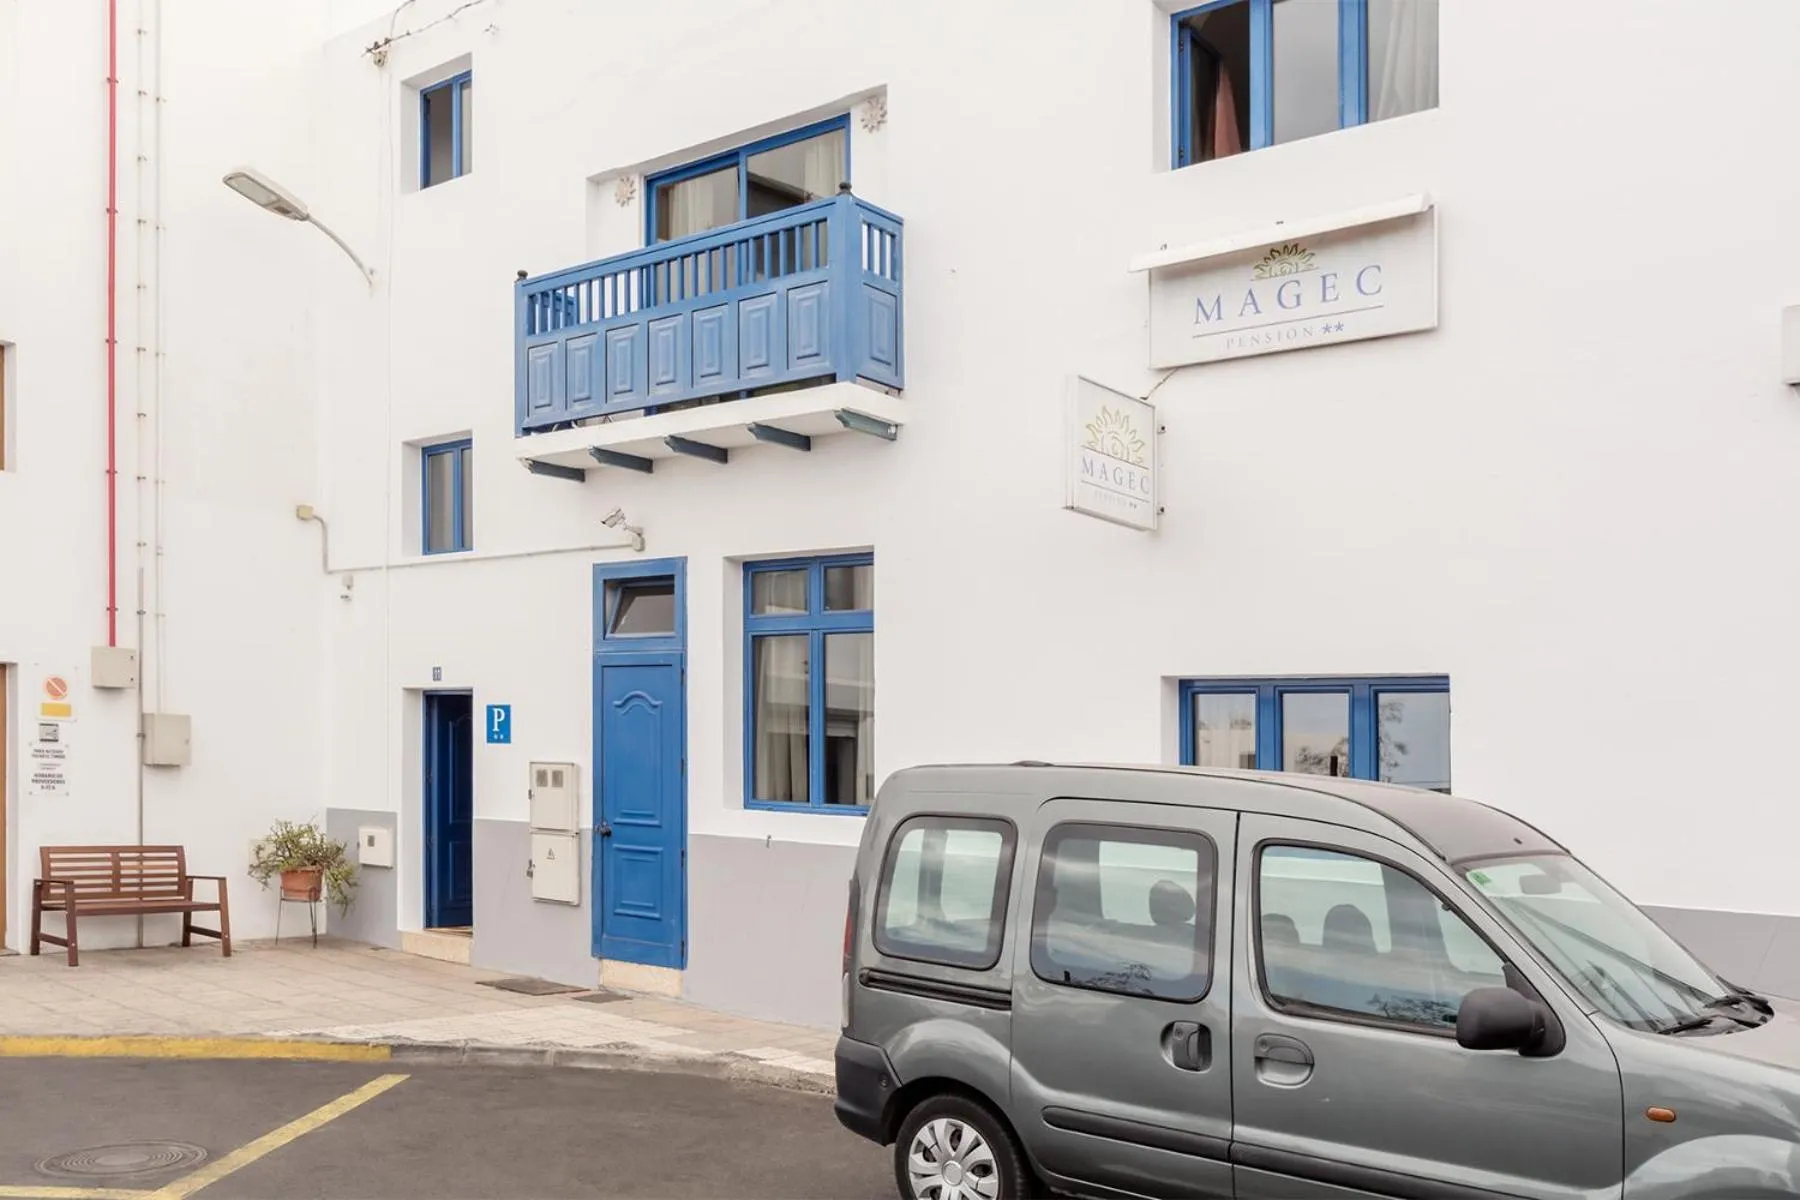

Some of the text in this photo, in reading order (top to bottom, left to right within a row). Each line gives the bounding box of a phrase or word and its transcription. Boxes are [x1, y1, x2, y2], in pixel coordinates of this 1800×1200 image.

[1194, 264, 1383, 325] MAGEC
[1225, 326, 1314, 350] PENSION
[1081, 455, 1150, 495] MAGEC
[492, 707, 505, 732] P
